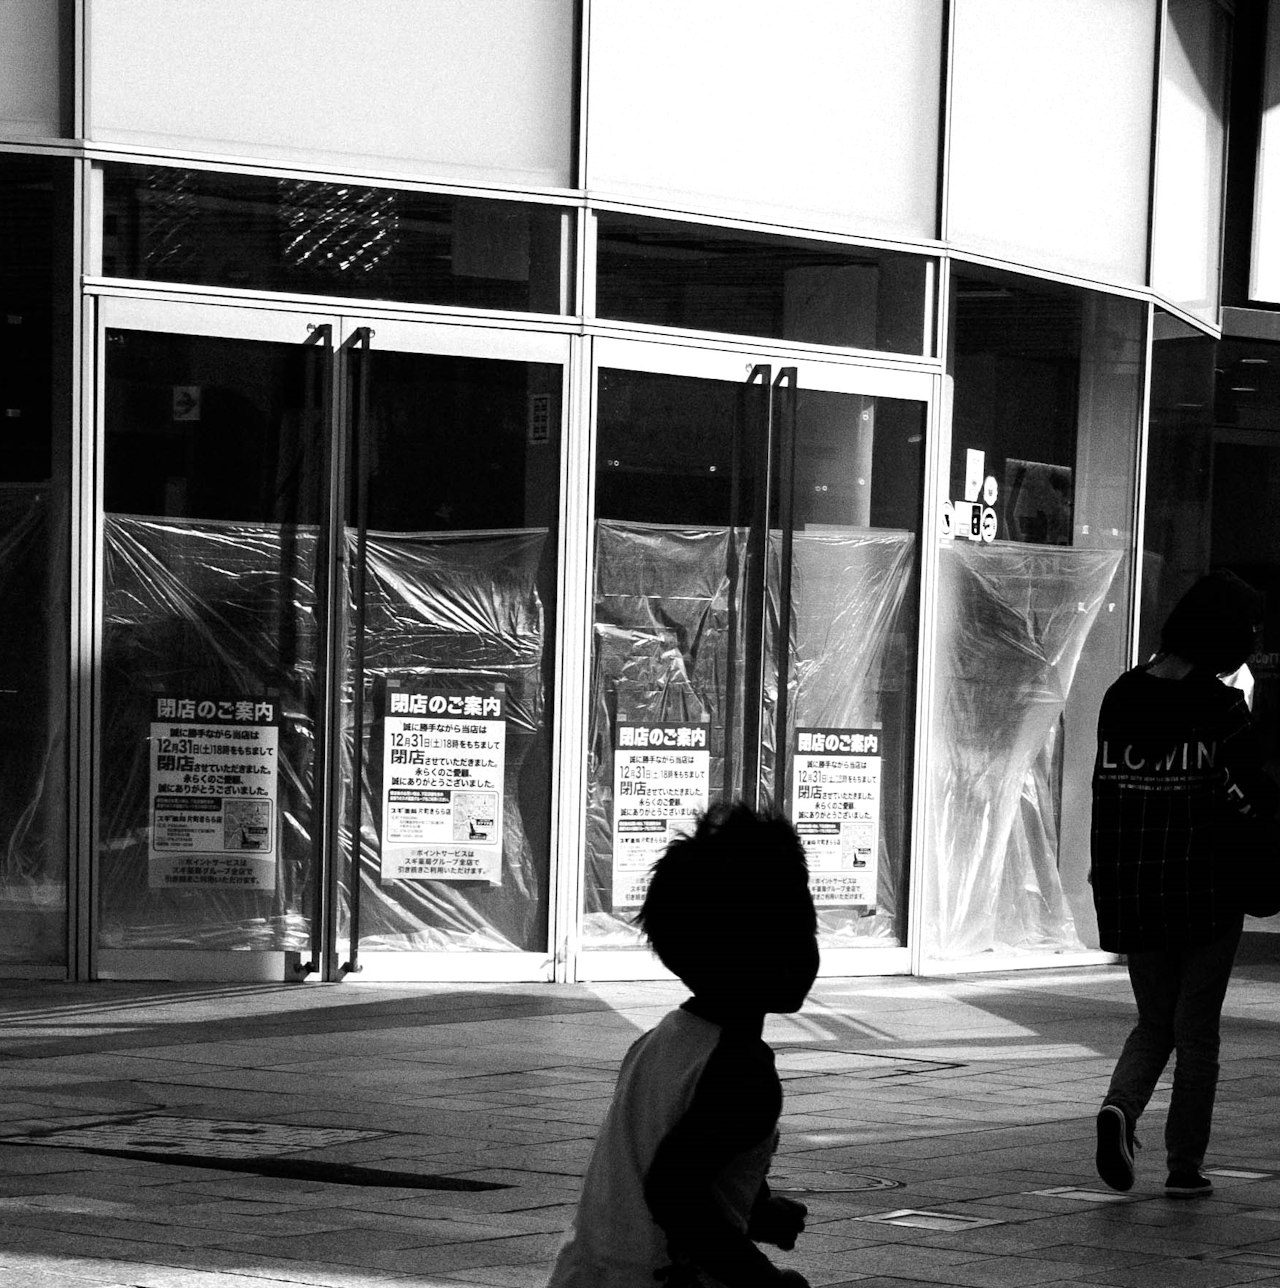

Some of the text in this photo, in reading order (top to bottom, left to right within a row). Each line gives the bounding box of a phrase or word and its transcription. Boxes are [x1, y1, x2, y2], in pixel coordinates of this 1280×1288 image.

[157, 698, 273, 722] 閉店のご案内
[391, 693, 500, 717] 閉店のご案内
[170, 727, 260, 739] 誠に勝手ながら当店は
[403, 722, 487, 733] 誠に勝手ながら当店は
[619, 726, 707, 748] 閉店のご案内
[798, 732, 878, 753] 閉店のご案内
[157, 755, 272, 775] 閉店させていただきました。
[391, 749, 498, 768] 閉店させていただきました。
[158, 784, 269, 796] 誠にありがとうございました。
[391, 777, 495, 788] 誠にありがとうございました。
